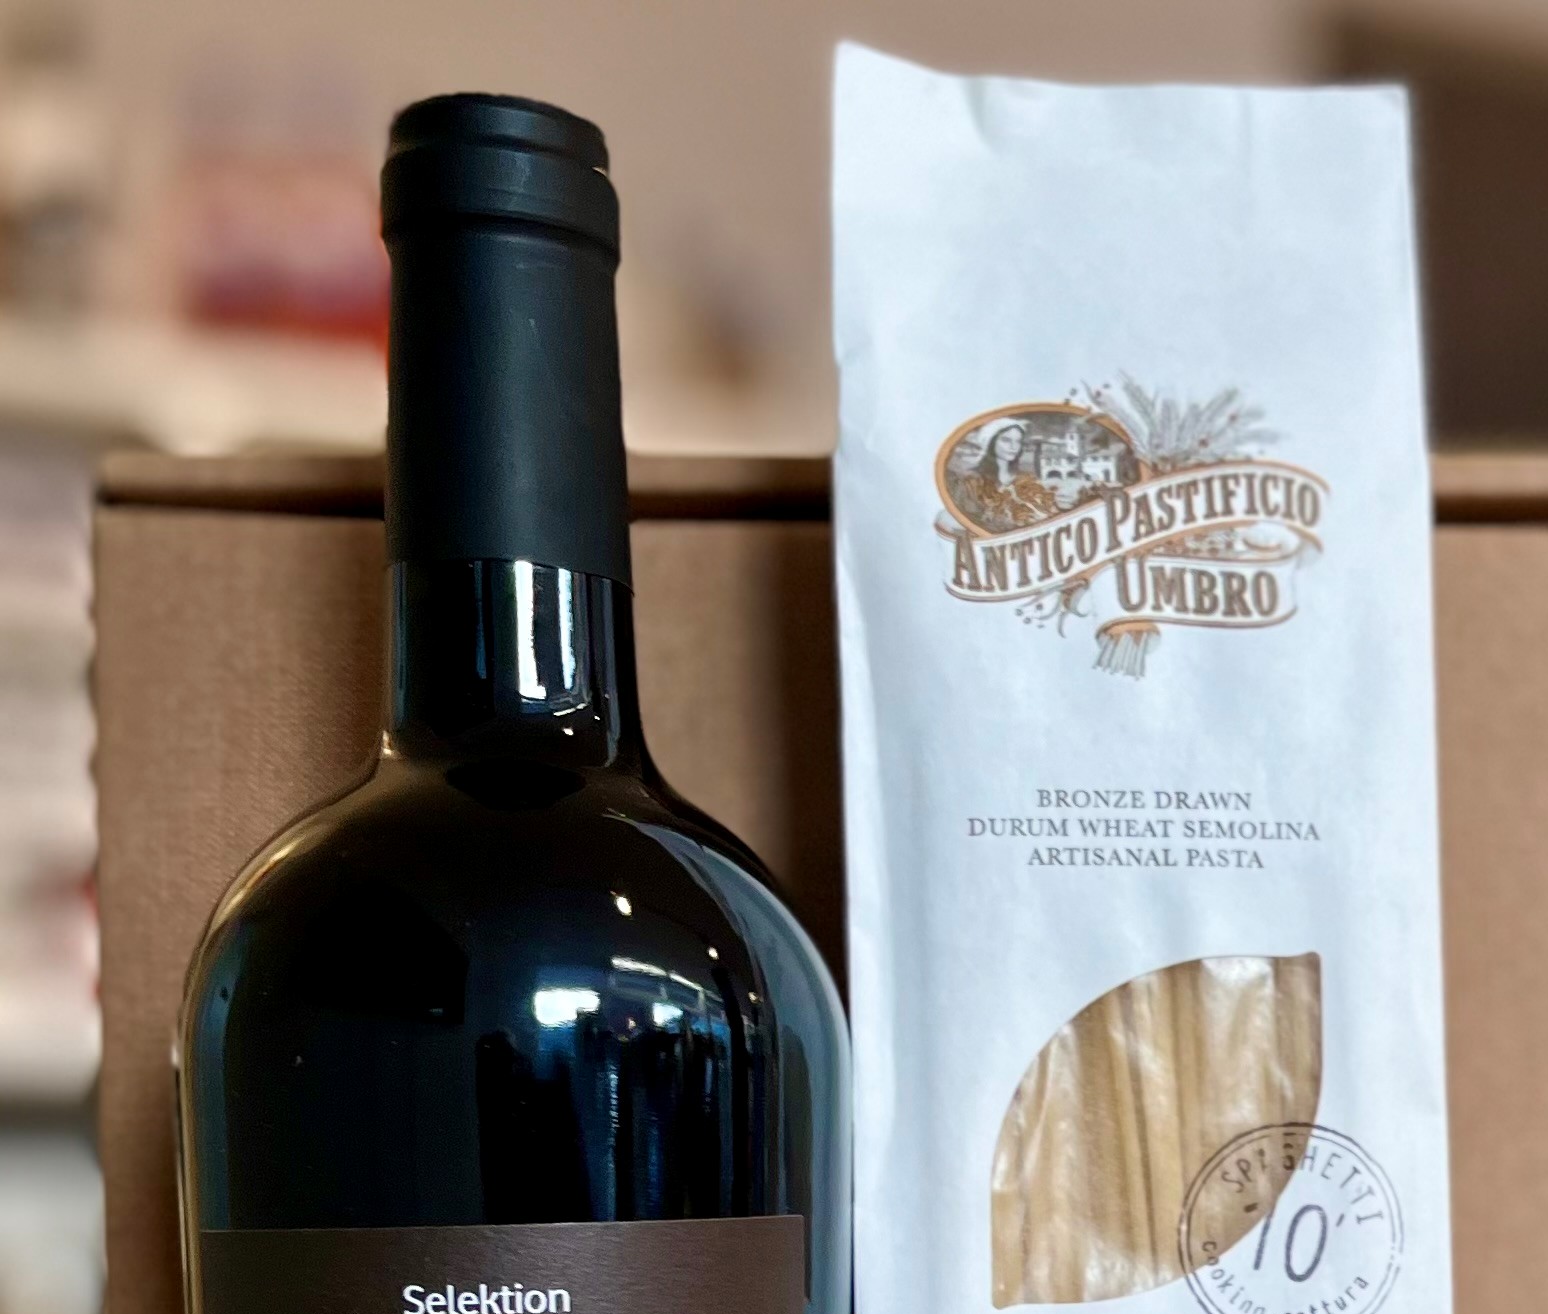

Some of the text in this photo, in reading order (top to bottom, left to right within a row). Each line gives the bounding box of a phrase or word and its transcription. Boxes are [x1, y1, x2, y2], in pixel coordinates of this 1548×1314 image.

[952, 472, 1321, 592] ANTICO PASTIFICIO
[1114, 556, 1279, 618] UMBRO
[1037, 789, 1252, 811] BRONZE DRAWN
[968, 817, 1321, 841] DURUM WHEAT SEMOLINA
[1027, 847, 1265, 869] ARTISANAL PASTA
